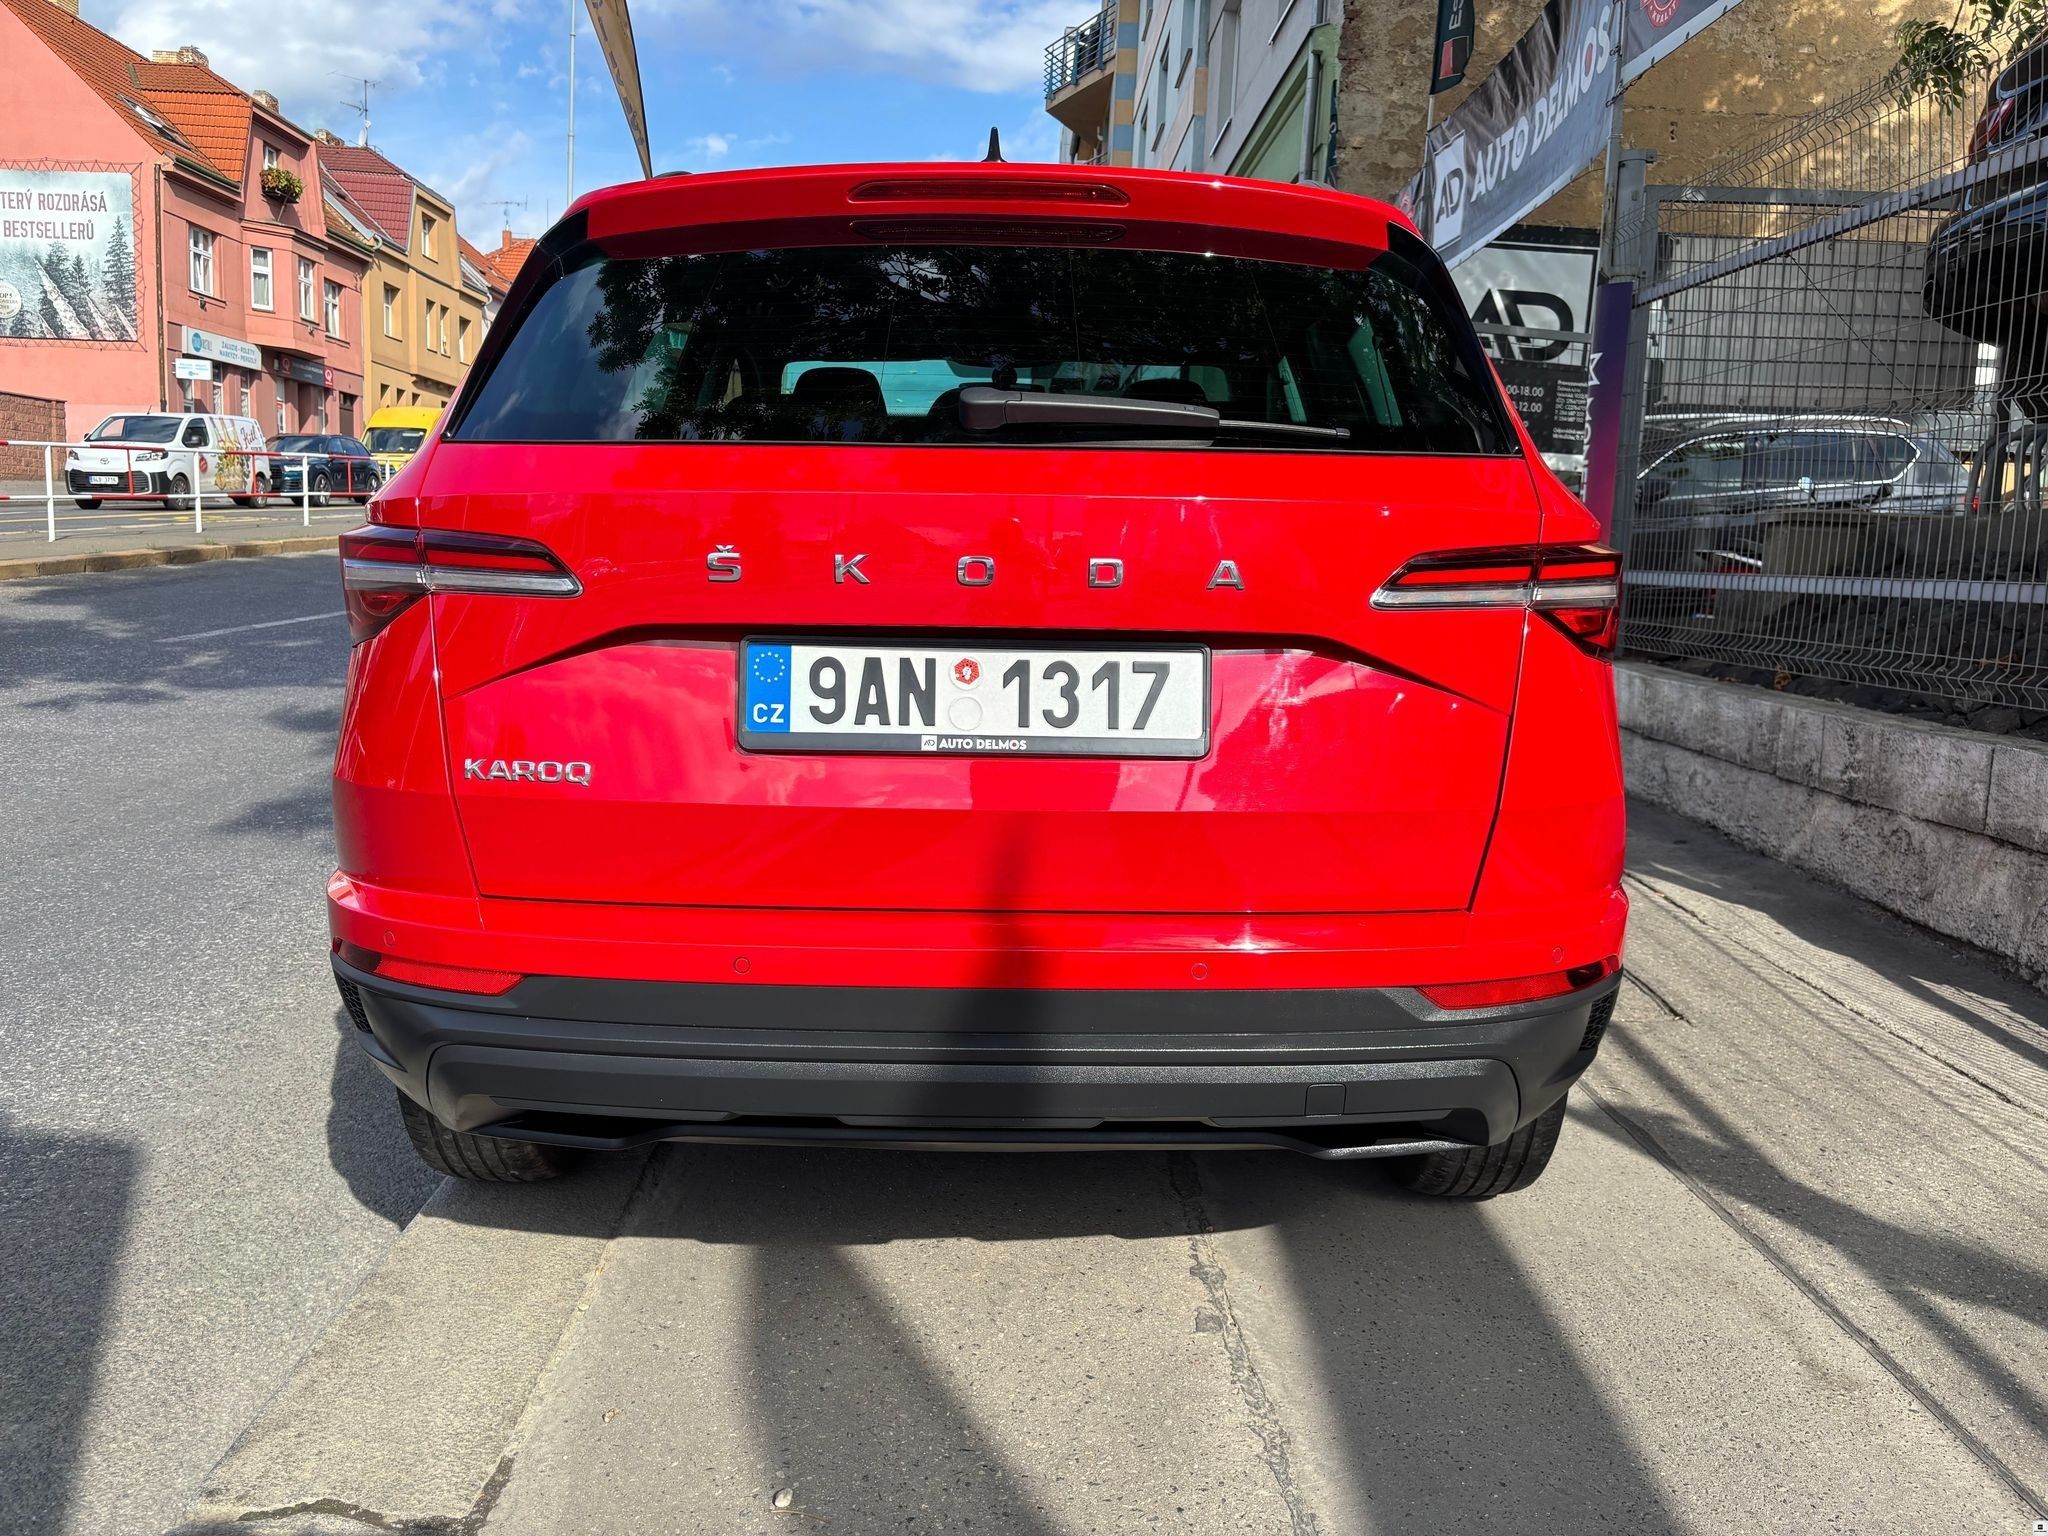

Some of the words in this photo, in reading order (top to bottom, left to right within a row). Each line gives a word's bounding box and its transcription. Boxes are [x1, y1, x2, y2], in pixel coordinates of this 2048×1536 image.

[1470, 119, 1529, 203] AUTO
[1530, 4, 1612, 157] DELMOS
[38, 190, 107, 212] ROZDRÁSÁ
[3, 219, 94, 240] BESTSELLERŮ
[752, 703, 785, 725] CZ
[808, 656, 938, 727] 9AN
[1002, 659, 1171, 732] 1317
[939, 738, 974, 749] AUTO
[976, 739, 1027, 750] DELMOS
[464, 758, 592, 786] KAROQ
